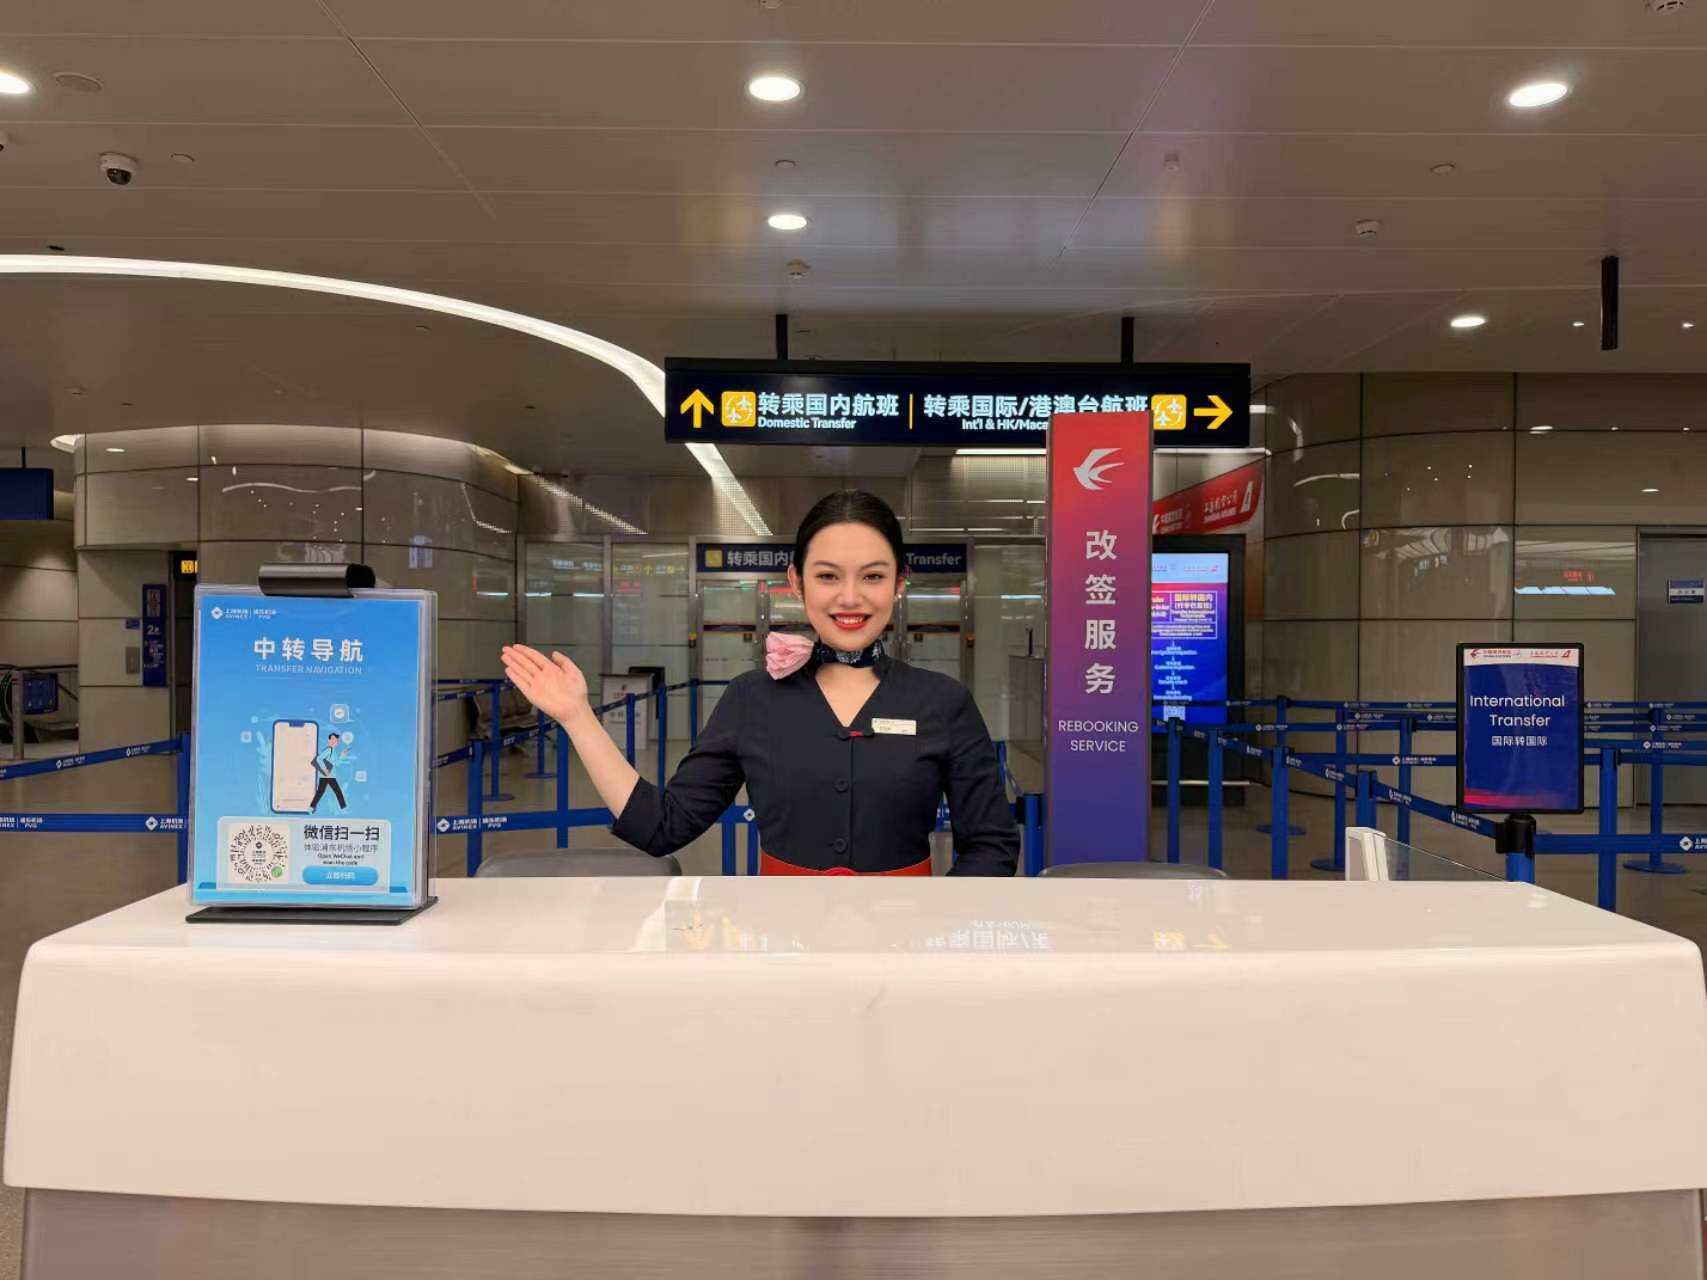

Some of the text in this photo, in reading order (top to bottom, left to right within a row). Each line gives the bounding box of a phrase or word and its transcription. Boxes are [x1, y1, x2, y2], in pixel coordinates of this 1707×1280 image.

[758, 392, 899, 417] 转乘国内航班
[924, 394, 1148, 418] 转乘国际/港澳台航班
[758, 417, 856, 429] Domestic Transfer
[962, 418, 1048, 430] Int'l & HK/Maca
[728, 551, 961, 566] 转乘国内 Transfer
[1084, 530, 1117, 694] 改签服务
[254, 637, 363, 662] 中转导航
[256, 664, 362, 674] TRANSFER NAVIGATION
[1470, 695, 1565, 707] International
[1489, 714, 1551, 726] Transfer
[1058, 720, 1139, 733] REBOOKING
[1070, 740, 1126, 752] SERVICE
[1491, 735, 1547, 746] 国际转国际
[304, 824, 380, 841] 微信扫一扫
